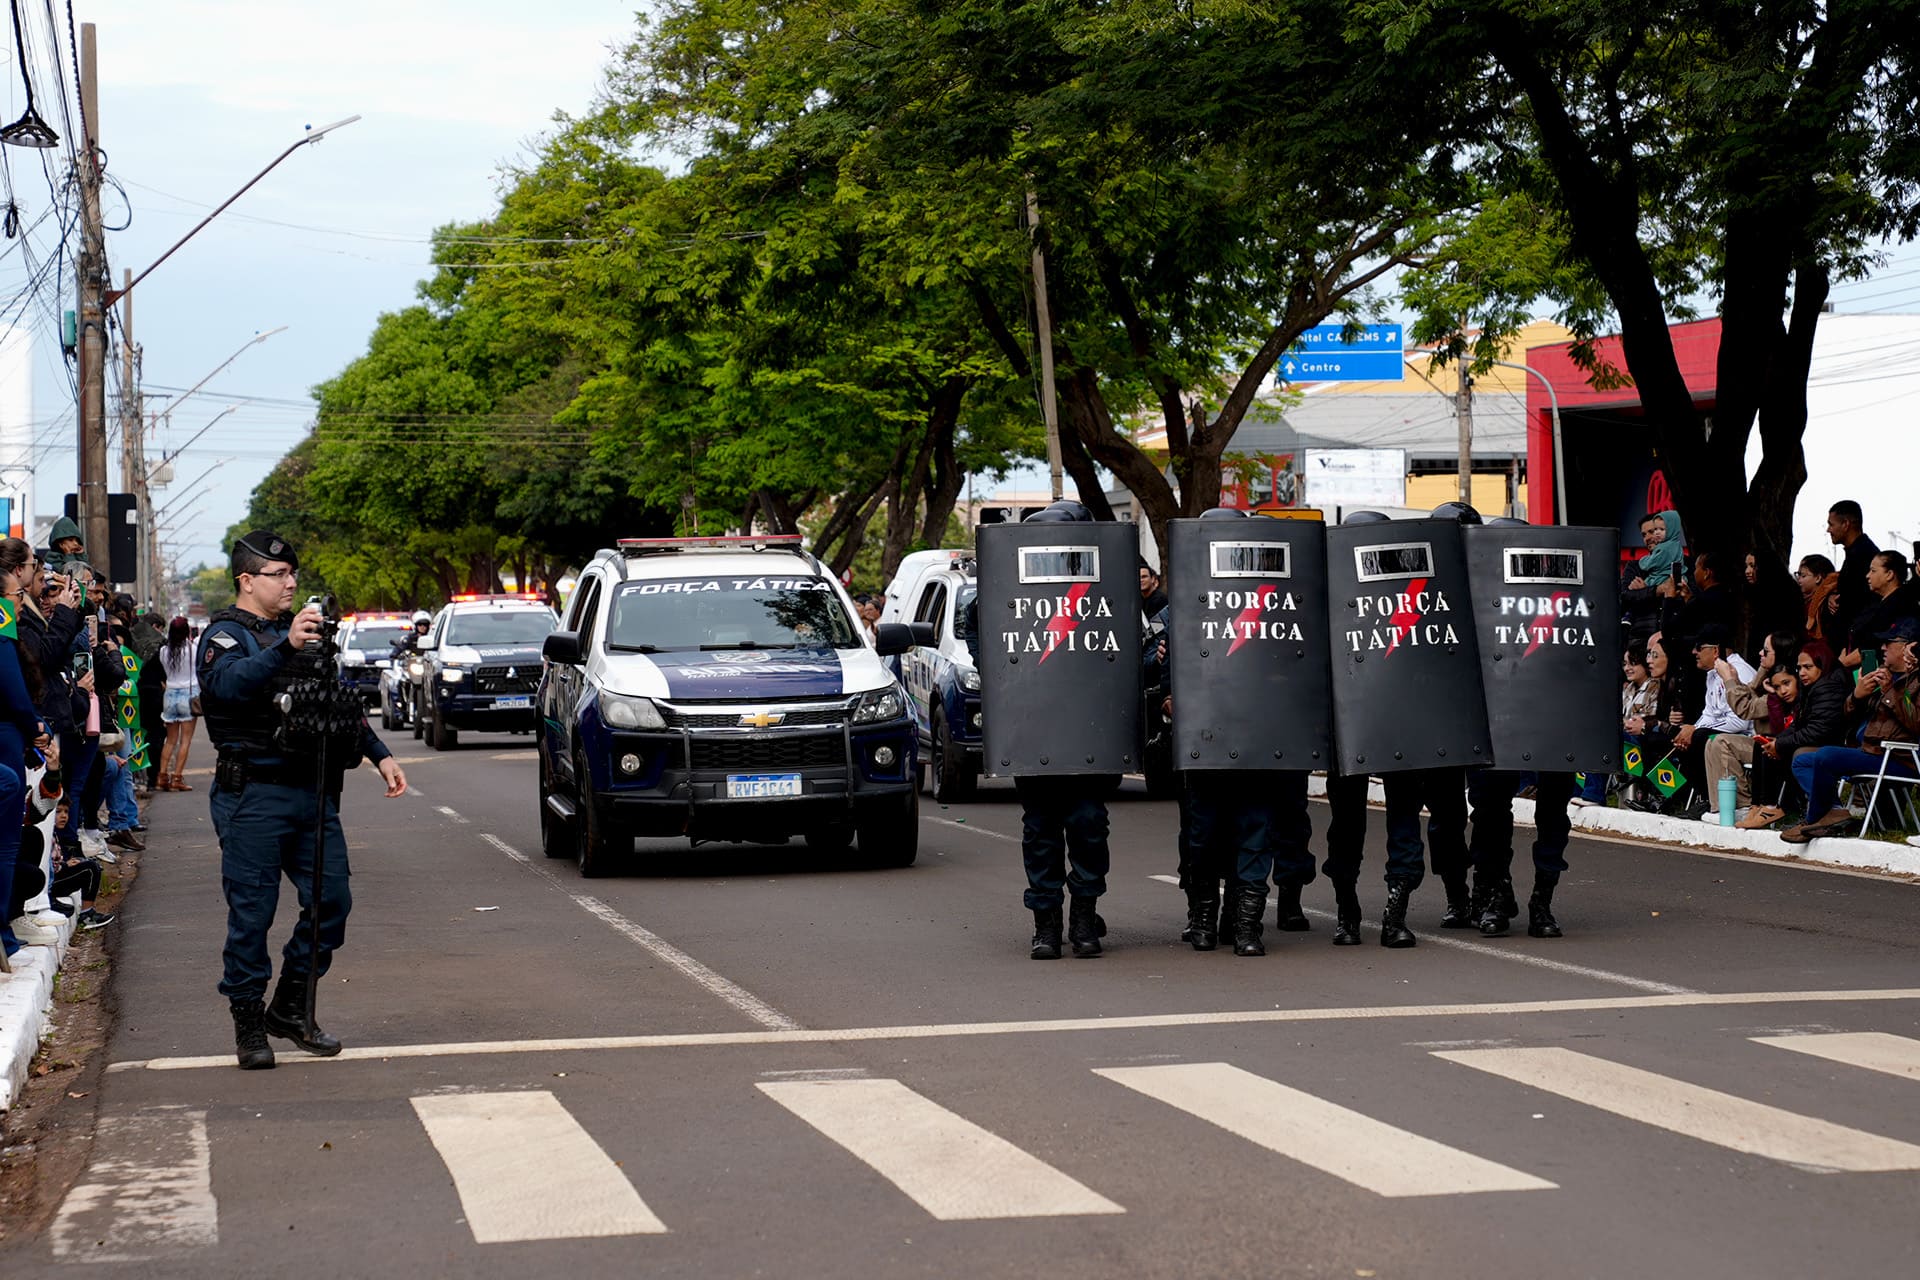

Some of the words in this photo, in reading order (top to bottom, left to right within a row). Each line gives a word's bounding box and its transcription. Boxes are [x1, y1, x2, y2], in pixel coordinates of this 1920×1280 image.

[1326, 332, 1380, 343] CAEMS
[1301, 362, 1342, 372] Centro
[620, 581, 721, 597] FORÇA
[731, 577, 832, 592] TÁTICA
[1014, 596, 1113, 621] FORÇA
[1207, 591, 1297, 612] FORÇA
[1355, 591, 1451, 618] FORÇA
[1500, 597, 1590, 618] FORÇA
[1002, 619, 1121, 653] TÁTICA
[1202, 617, 1305, 641] TÁTICA
[1345, 618, 1460, 652] TÁTICA
[1495, 622, 1596, 646] TÁTICA
